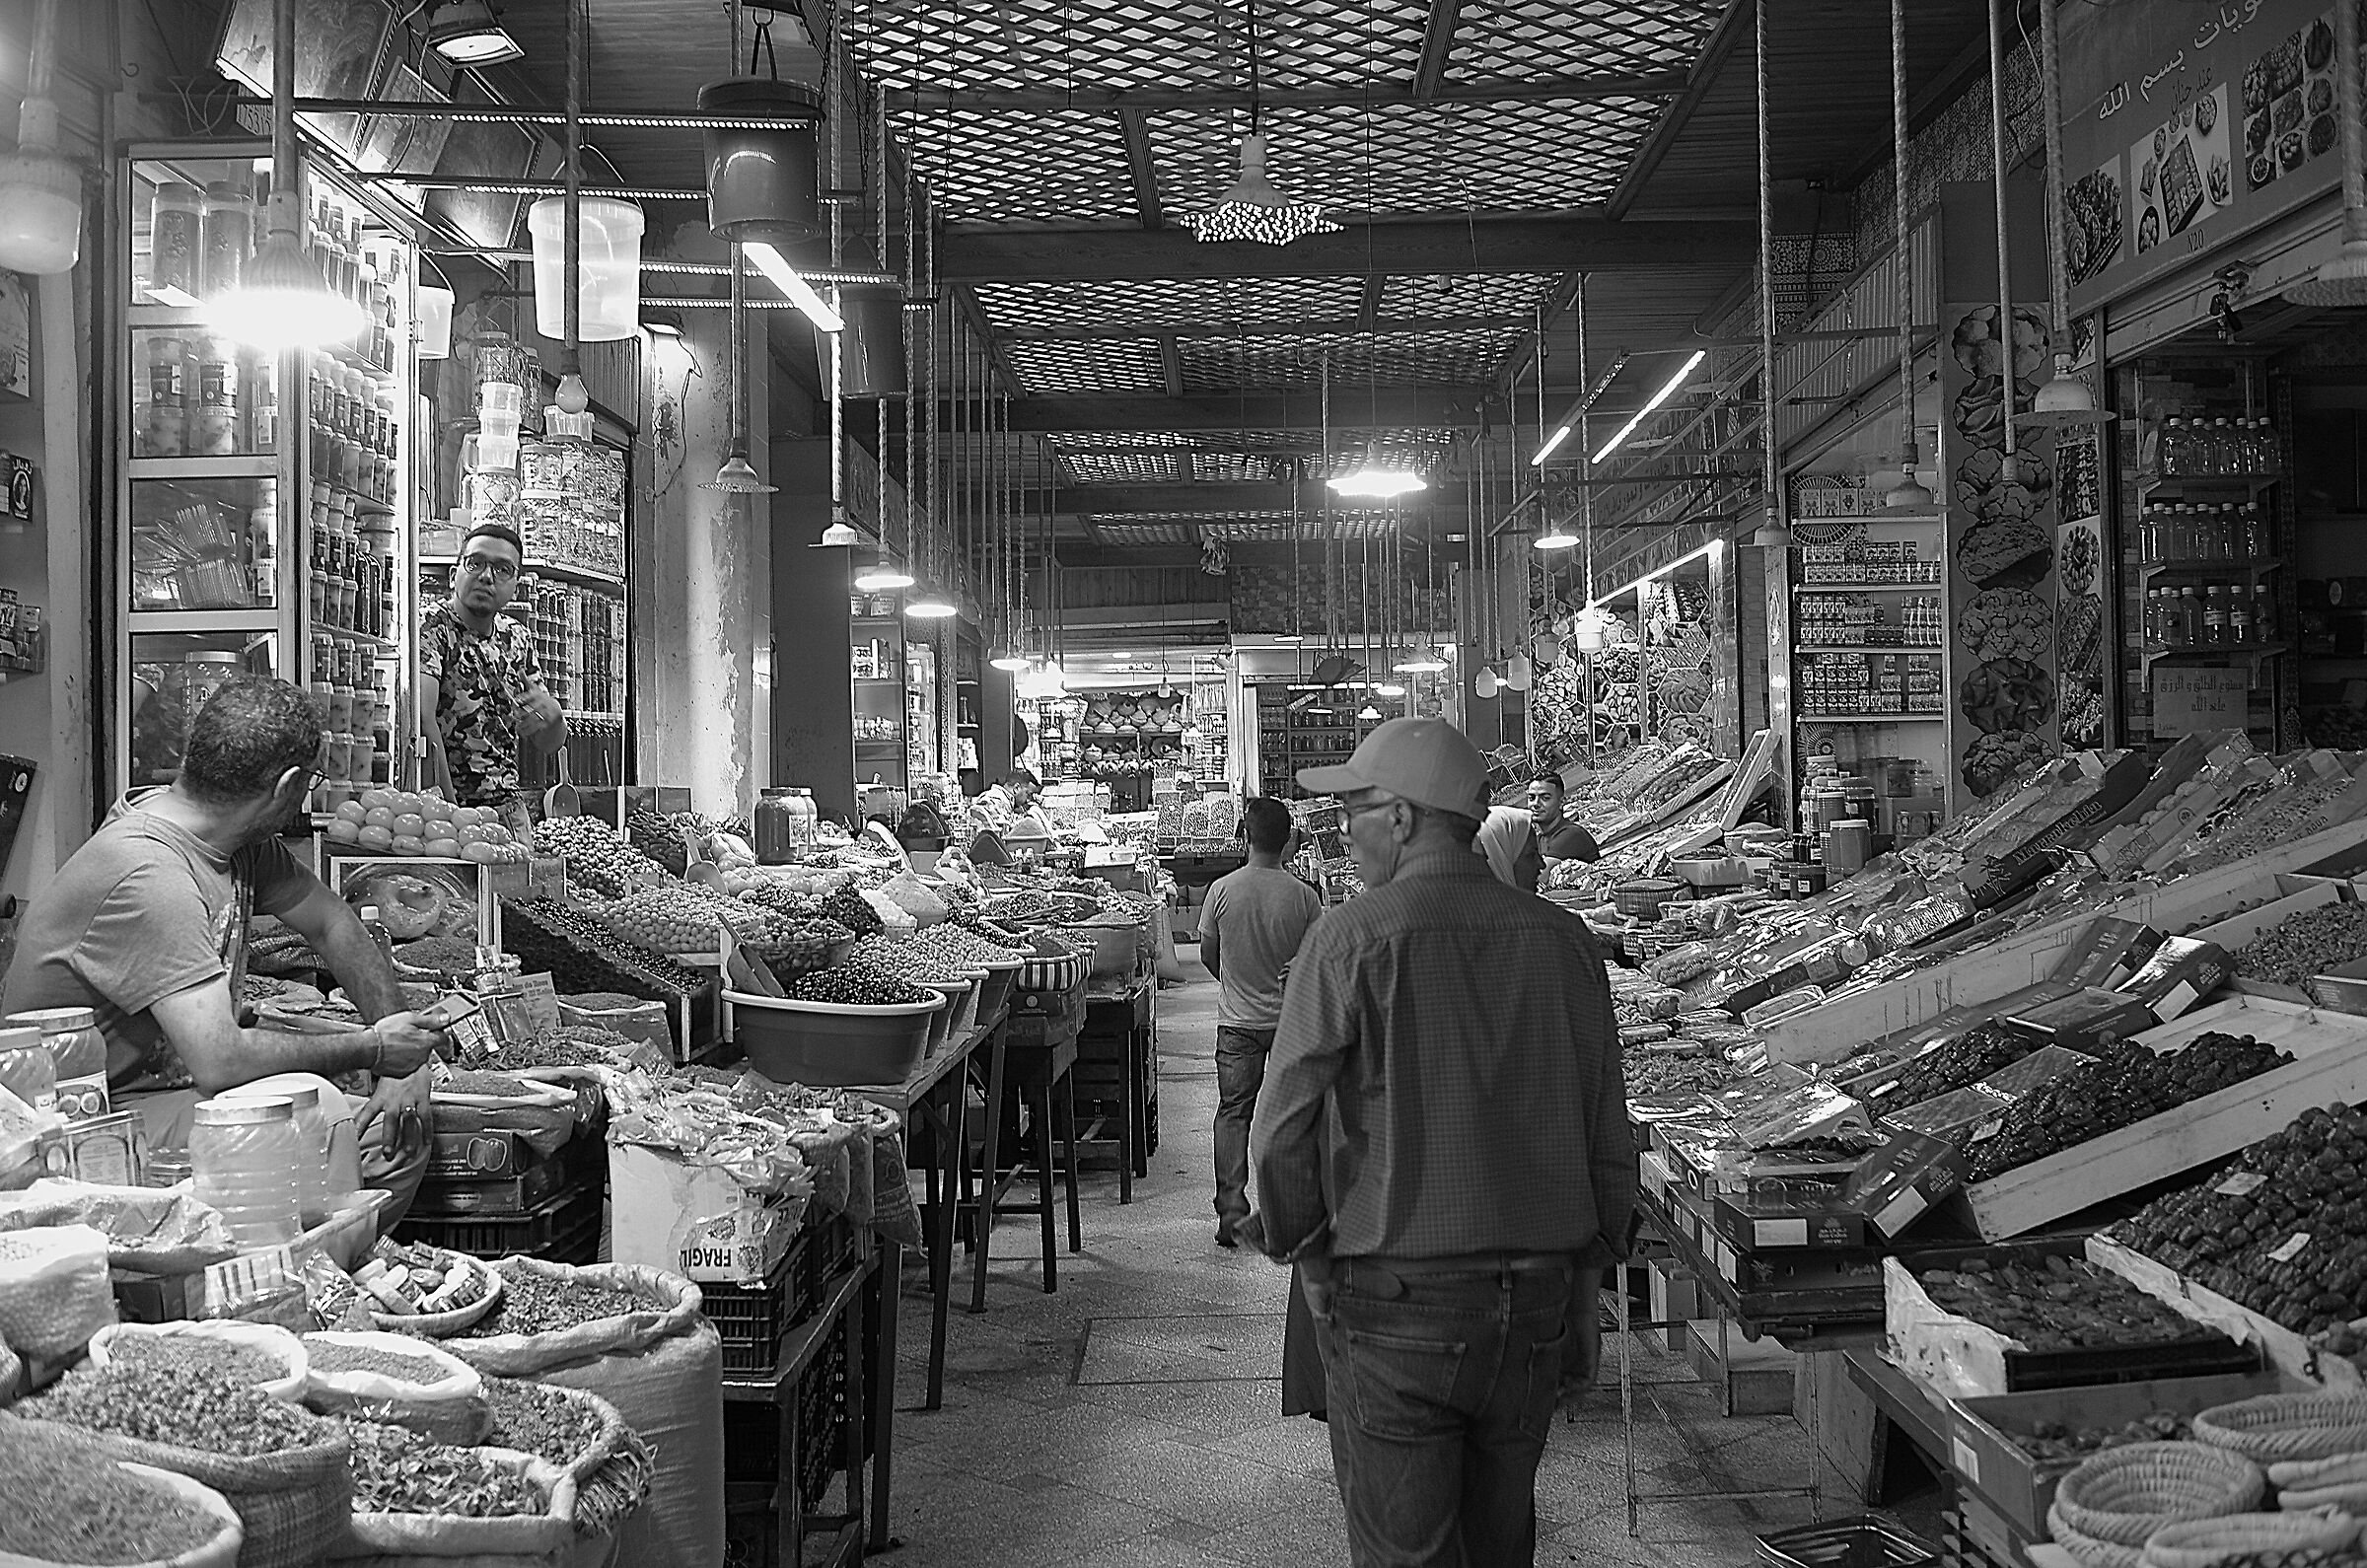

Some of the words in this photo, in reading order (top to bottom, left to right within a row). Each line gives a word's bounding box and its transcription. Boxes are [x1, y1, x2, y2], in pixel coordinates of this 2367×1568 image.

[2139, 49, 2186, 103] بسم
[2099, 81, 2130, 119] الله
[2190, 696, 2206, 712] الله
